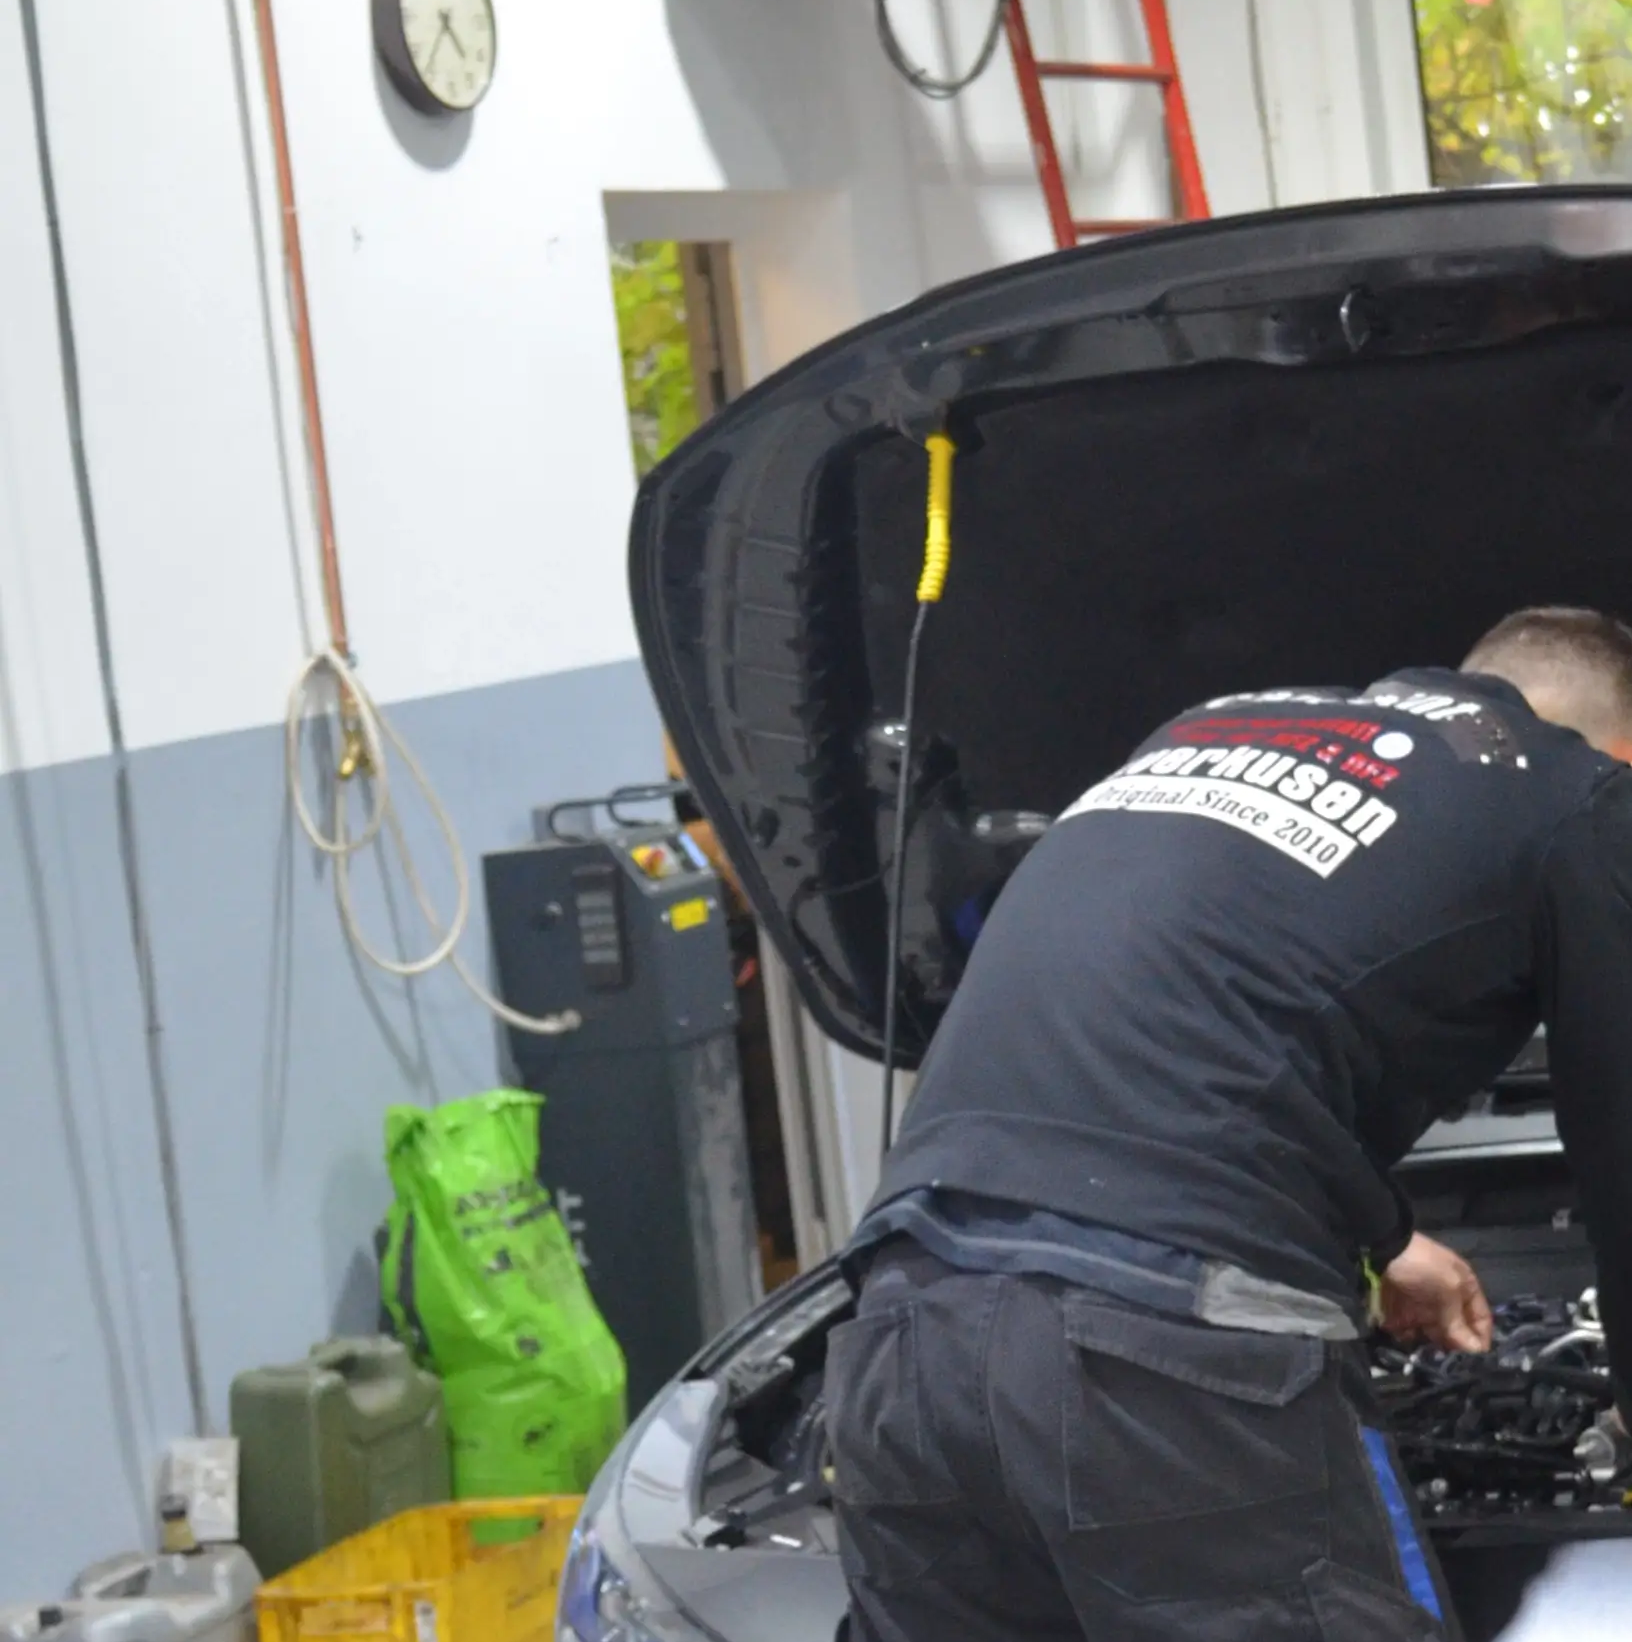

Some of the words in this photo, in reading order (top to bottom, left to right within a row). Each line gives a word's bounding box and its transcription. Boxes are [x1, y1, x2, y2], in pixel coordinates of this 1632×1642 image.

[1106, 745, 1398, 847] verkusen
[1197, 789, 1269, 826] Since
[1273, 818, 1339, 864] 2010
